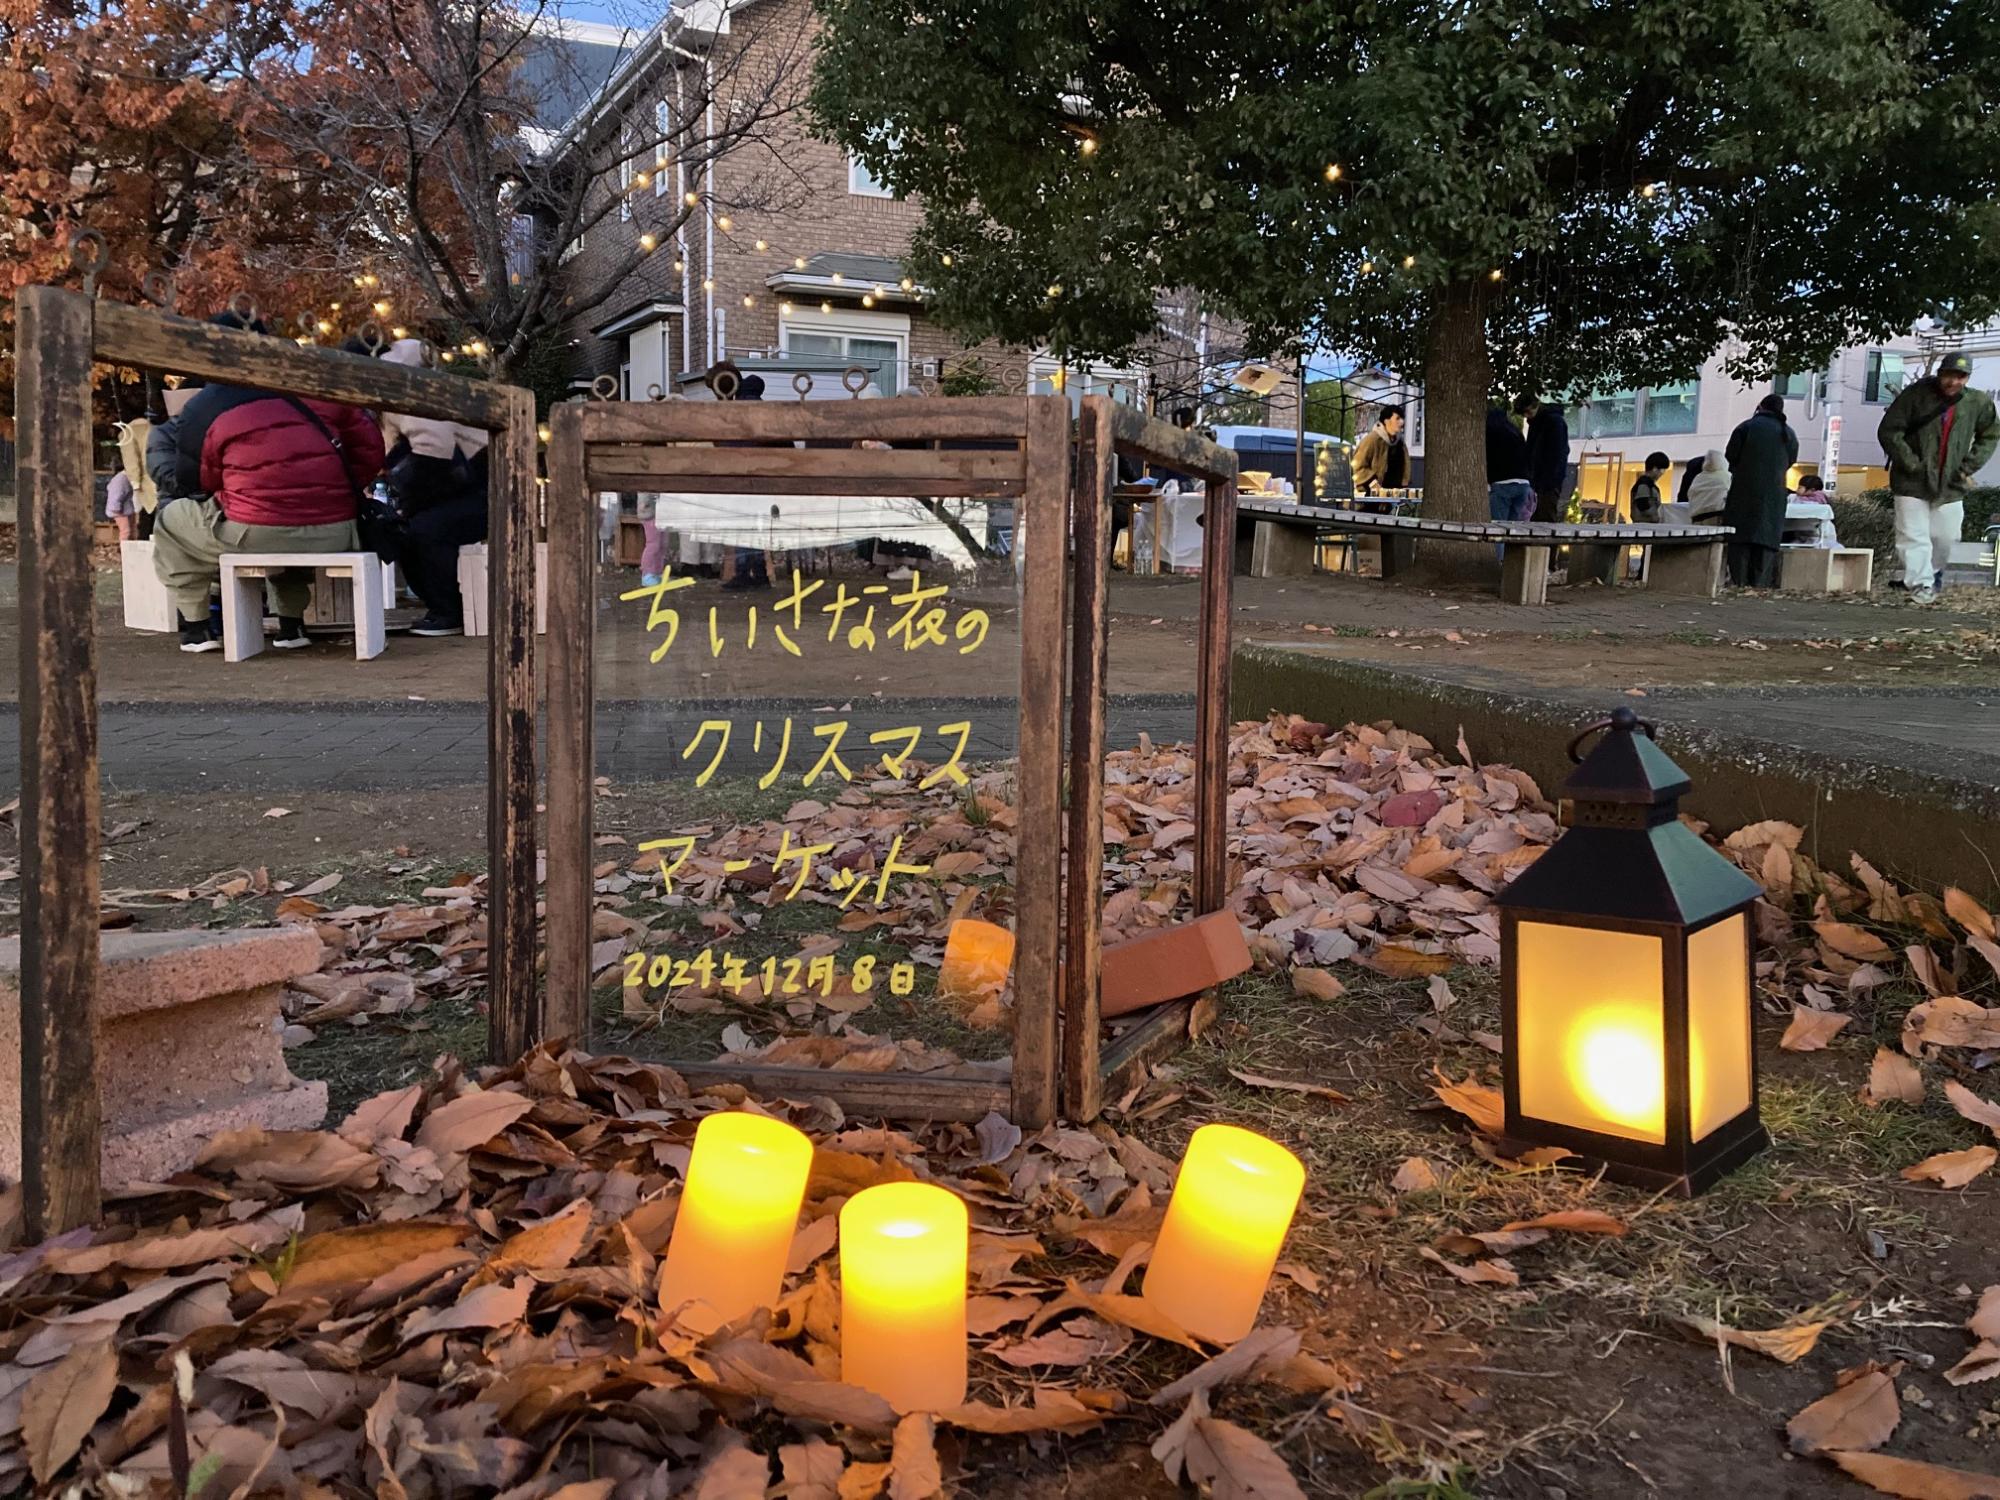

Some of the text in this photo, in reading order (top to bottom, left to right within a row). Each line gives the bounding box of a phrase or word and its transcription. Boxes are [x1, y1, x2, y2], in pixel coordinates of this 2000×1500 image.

[620, 564, 990, 664] ちいさな夜の
[682, 718, 972, 790] クリスマス
[638, 830, 931, 909] マーケット
[623, 948, 915, 996] 2024年12月8日
